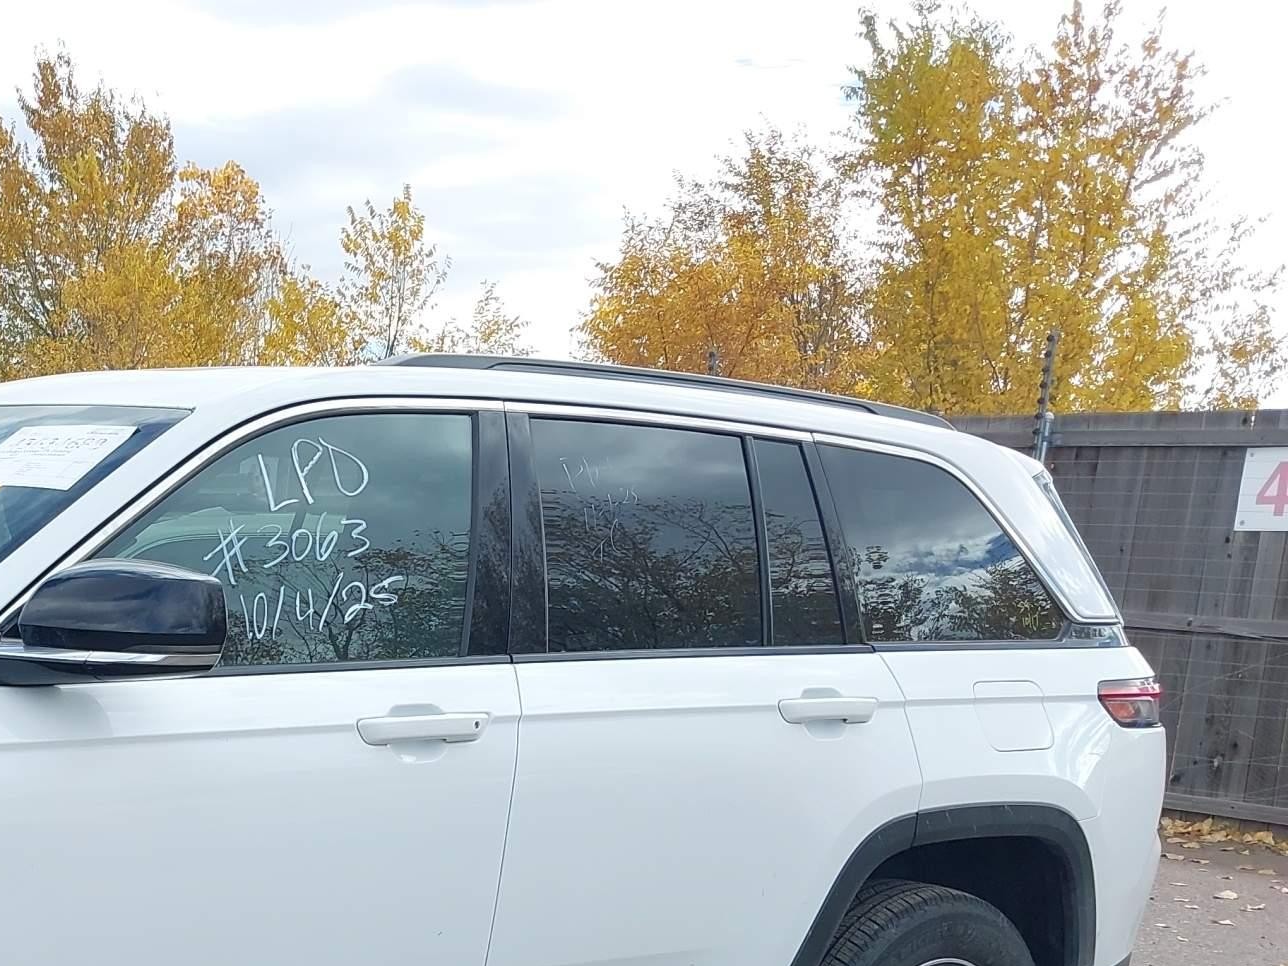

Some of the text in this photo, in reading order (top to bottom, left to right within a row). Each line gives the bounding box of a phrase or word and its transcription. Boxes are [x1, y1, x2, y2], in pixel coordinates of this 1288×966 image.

[258, 437, 369, 512] LPD
[203, 512, 371, 586] #3063
[240, 572, 405, 640] 10/4/25
